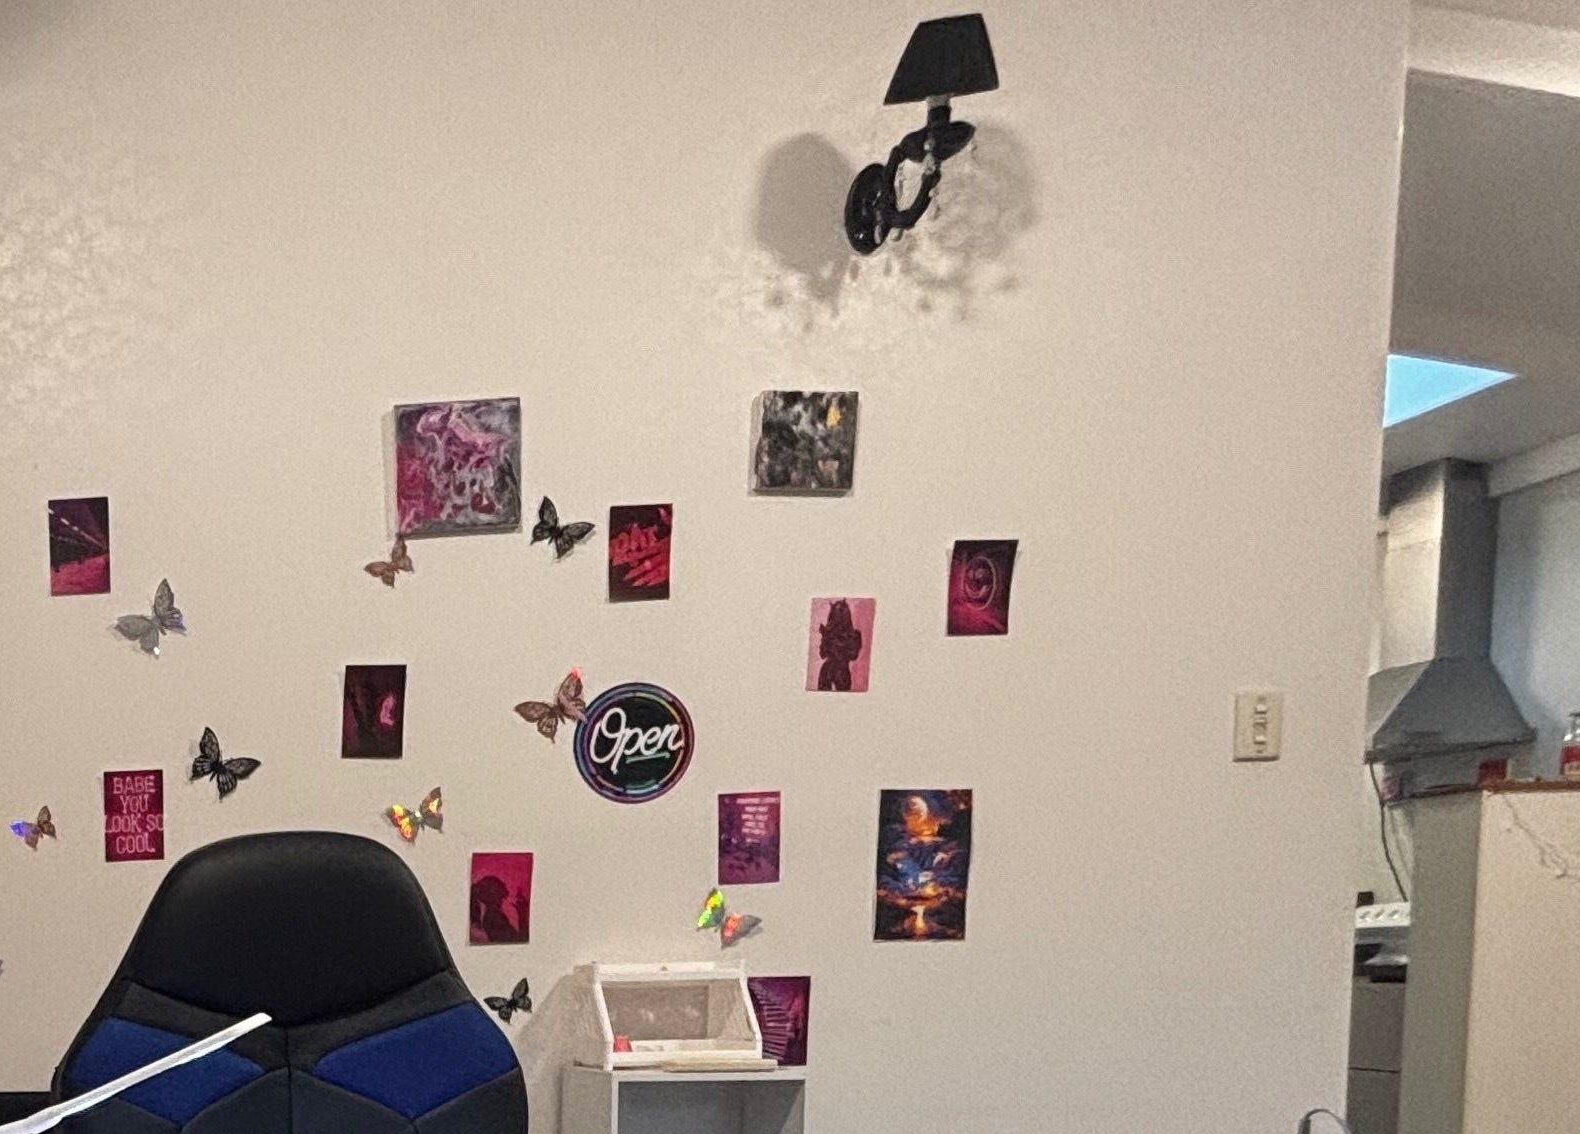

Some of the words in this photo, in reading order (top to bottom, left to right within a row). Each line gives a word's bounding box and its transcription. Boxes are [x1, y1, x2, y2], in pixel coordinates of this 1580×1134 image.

[589, 706, 685, 775] Open
[113, 775, 156, 795] BABE
[119, 794, 149, 814] YOU
[116, 832, 156, 854] COOL
